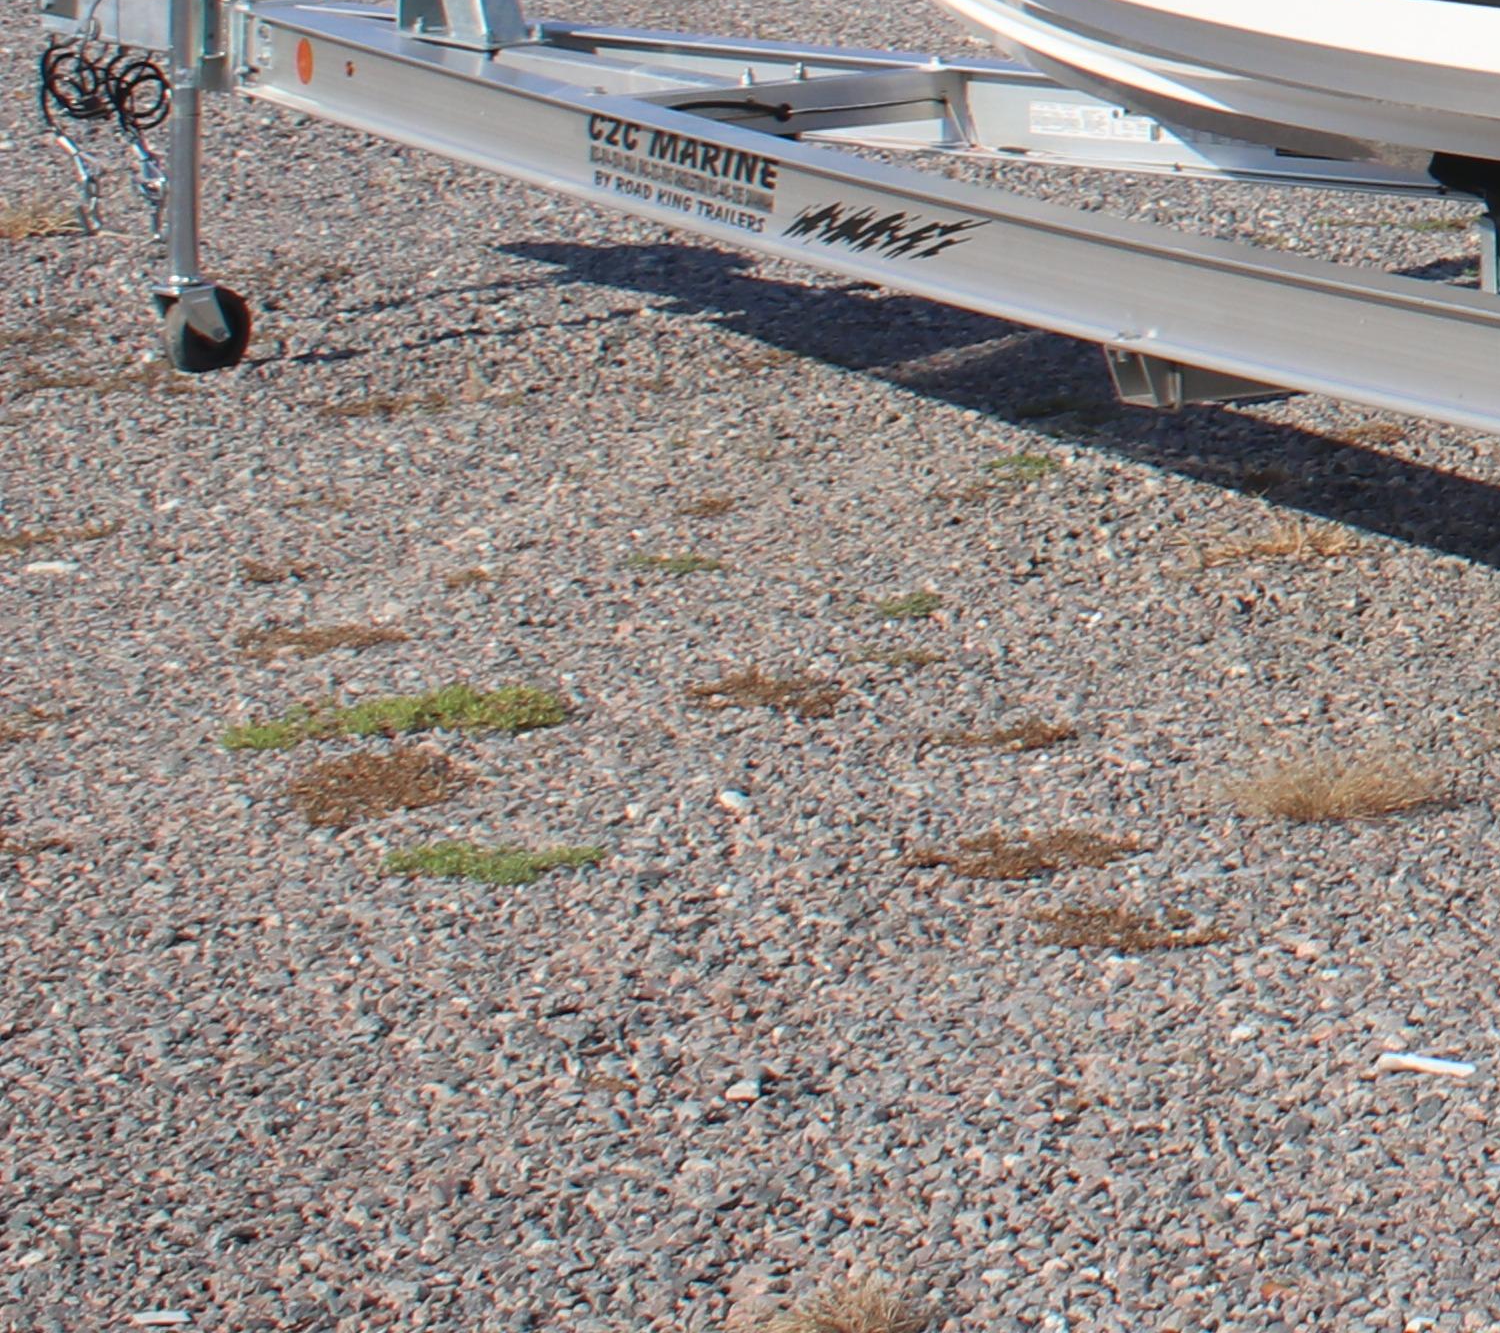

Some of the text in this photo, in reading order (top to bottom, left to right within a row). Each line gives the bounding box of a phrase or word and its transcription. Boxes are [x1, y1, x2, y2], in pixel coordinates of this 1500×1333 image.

[649, 129, 780, 190] MARINE
[594, 170, 612, 187] BY
[616, 176, 653, 200] ROAD
[657, 188, 693, 212] KING
[697, 199, 766, 233] TRAILERS
